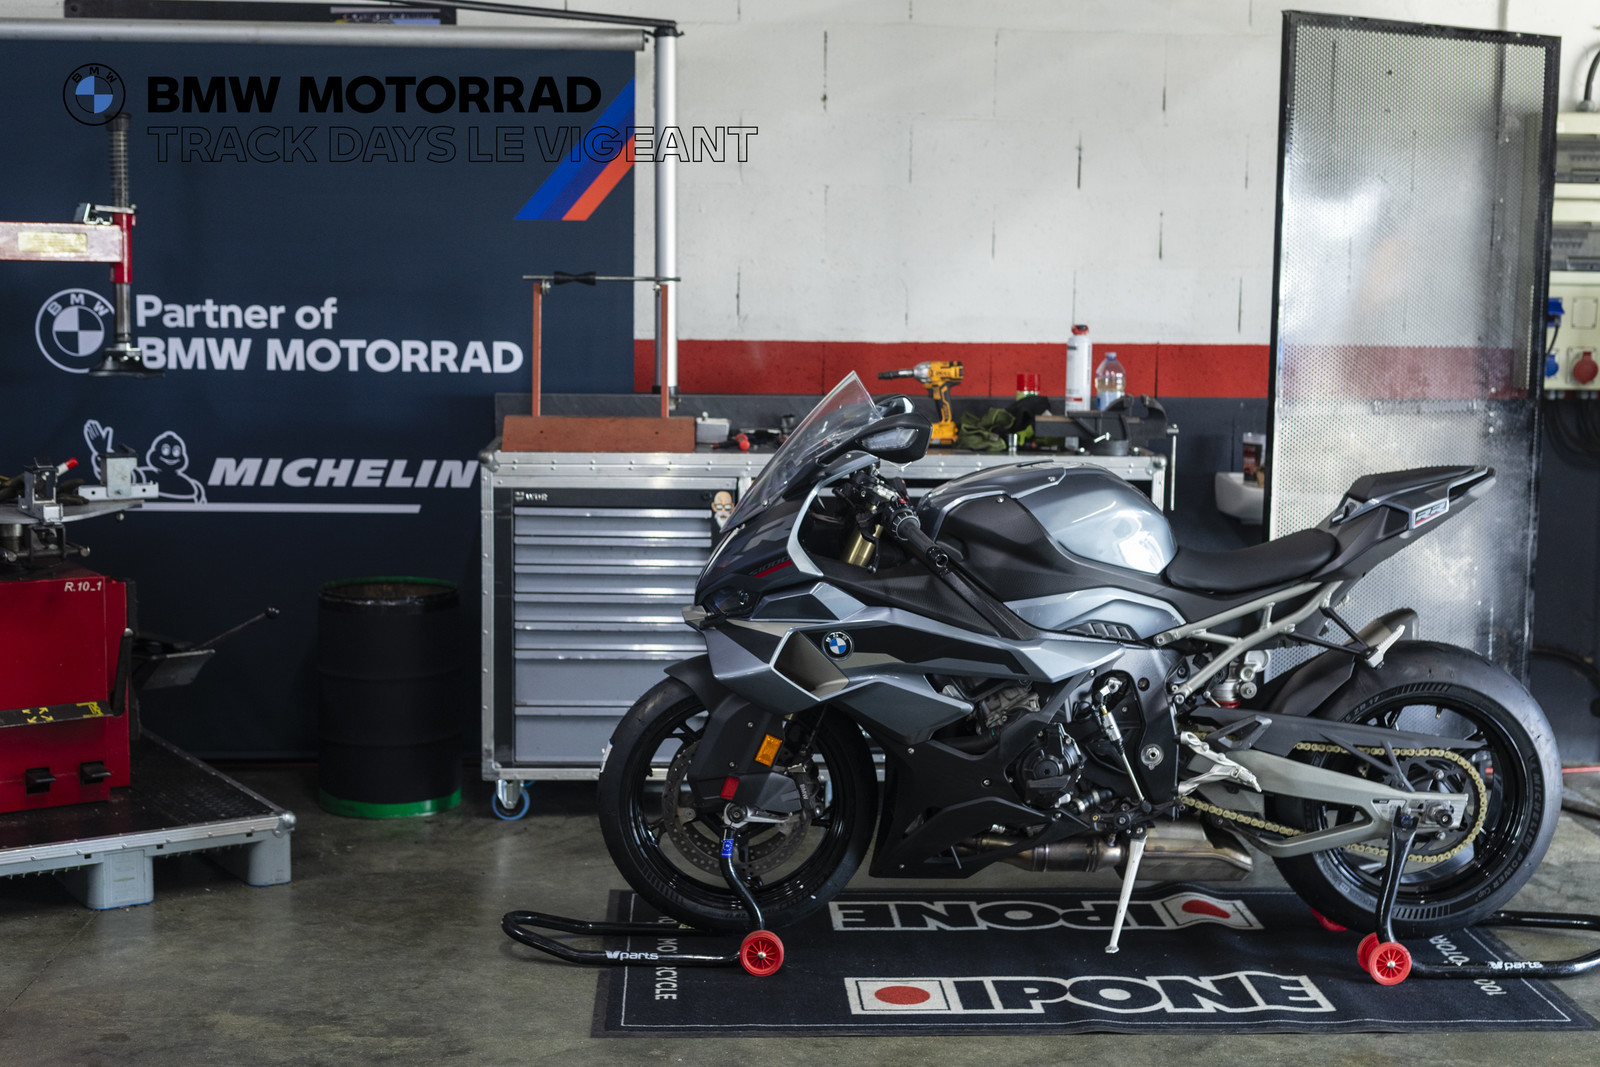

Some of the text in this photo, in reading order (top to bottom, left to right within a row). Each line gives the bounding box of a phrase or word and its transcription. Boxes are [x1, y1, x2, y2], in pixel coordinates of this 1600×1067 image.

[135, 294, 338, 330] Partner of
[137, 336, 524, 374] BMW MOTORRAD
[207, 457, 479, 488] MICHELIN
[1525, 771, 1543, 848] MICHELIN
[1492, 852, 1524, 890] POWER
[828, 901, 1168, 931] IPONE
[951, 971, 1337, 1014] IPONE
